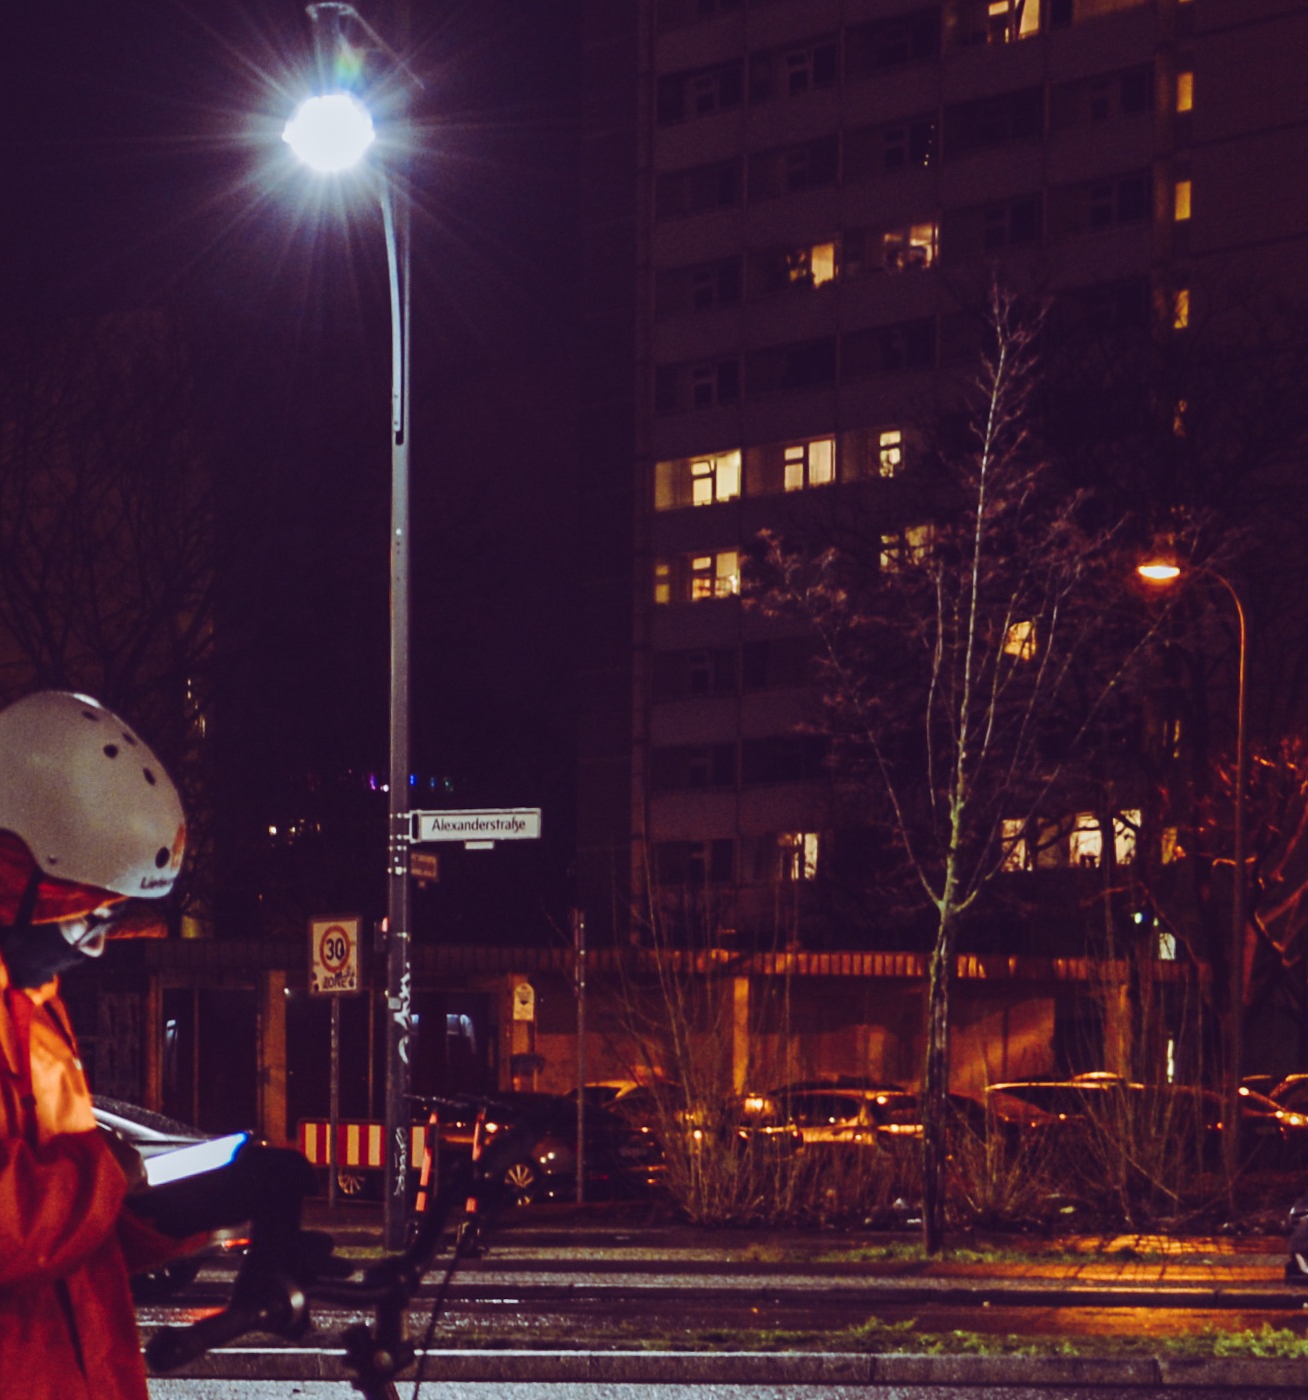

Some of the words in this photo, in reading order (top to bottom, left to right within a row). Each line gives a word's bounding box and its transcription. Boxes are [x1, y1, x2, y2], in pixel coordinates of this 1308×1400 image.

[431, 816, 526, 833] Alexanderstraße
[325, 937, 345, 961] 30
[322, 975, 347, 989] ZONE
